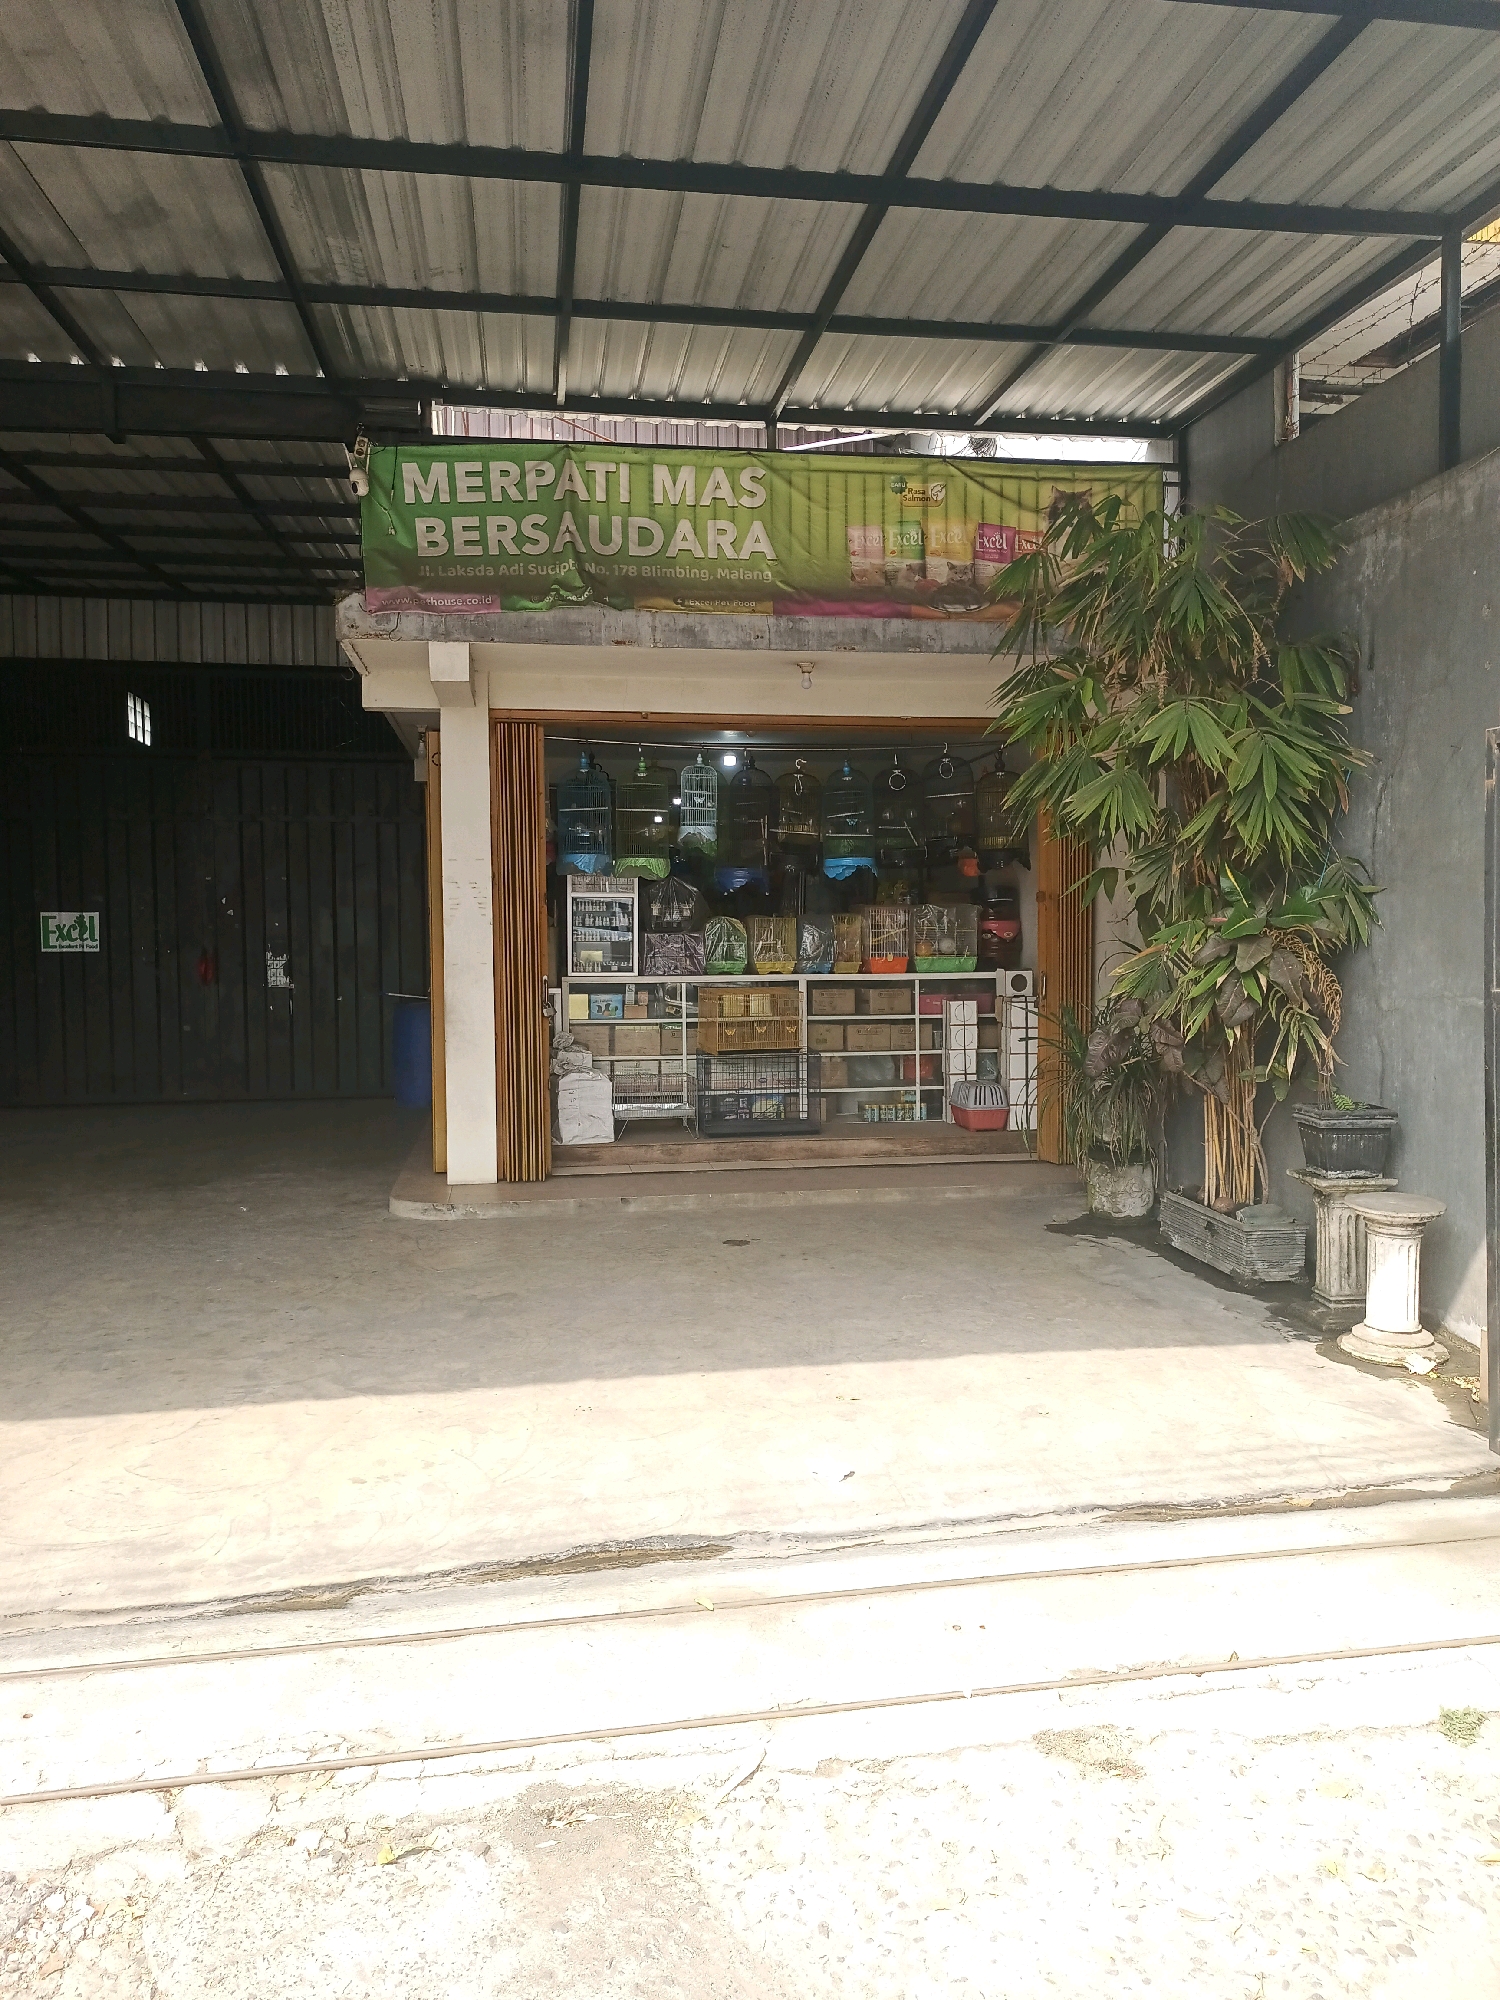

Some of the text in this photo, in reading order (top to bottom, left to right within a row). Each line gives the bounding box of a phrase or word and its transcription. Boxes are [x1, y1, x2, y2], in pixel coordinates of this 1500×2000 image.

[401, 458, 768, 508] MERPATI MAS
[907, 487, 926, 495] Rasa
[902, 494, 931, 502] Salmon
[414, 511, 780, 560] BERSAUDARA
[889, 528, 924, 549] Excel
[930, 525, 968, 547] Excel
[975, 530, 1008, 551] Excel
[438, 564, 495, 576] Laksda
[499, 563, 524, 576] Adi
[588, 562, 610, 575] No.
[612, 564, 638, 576] 178
[641, 565, 714, 581] Blimbing,
[717, 568, 772, 583] Malang
[42, 914, 99, 949] Excel
